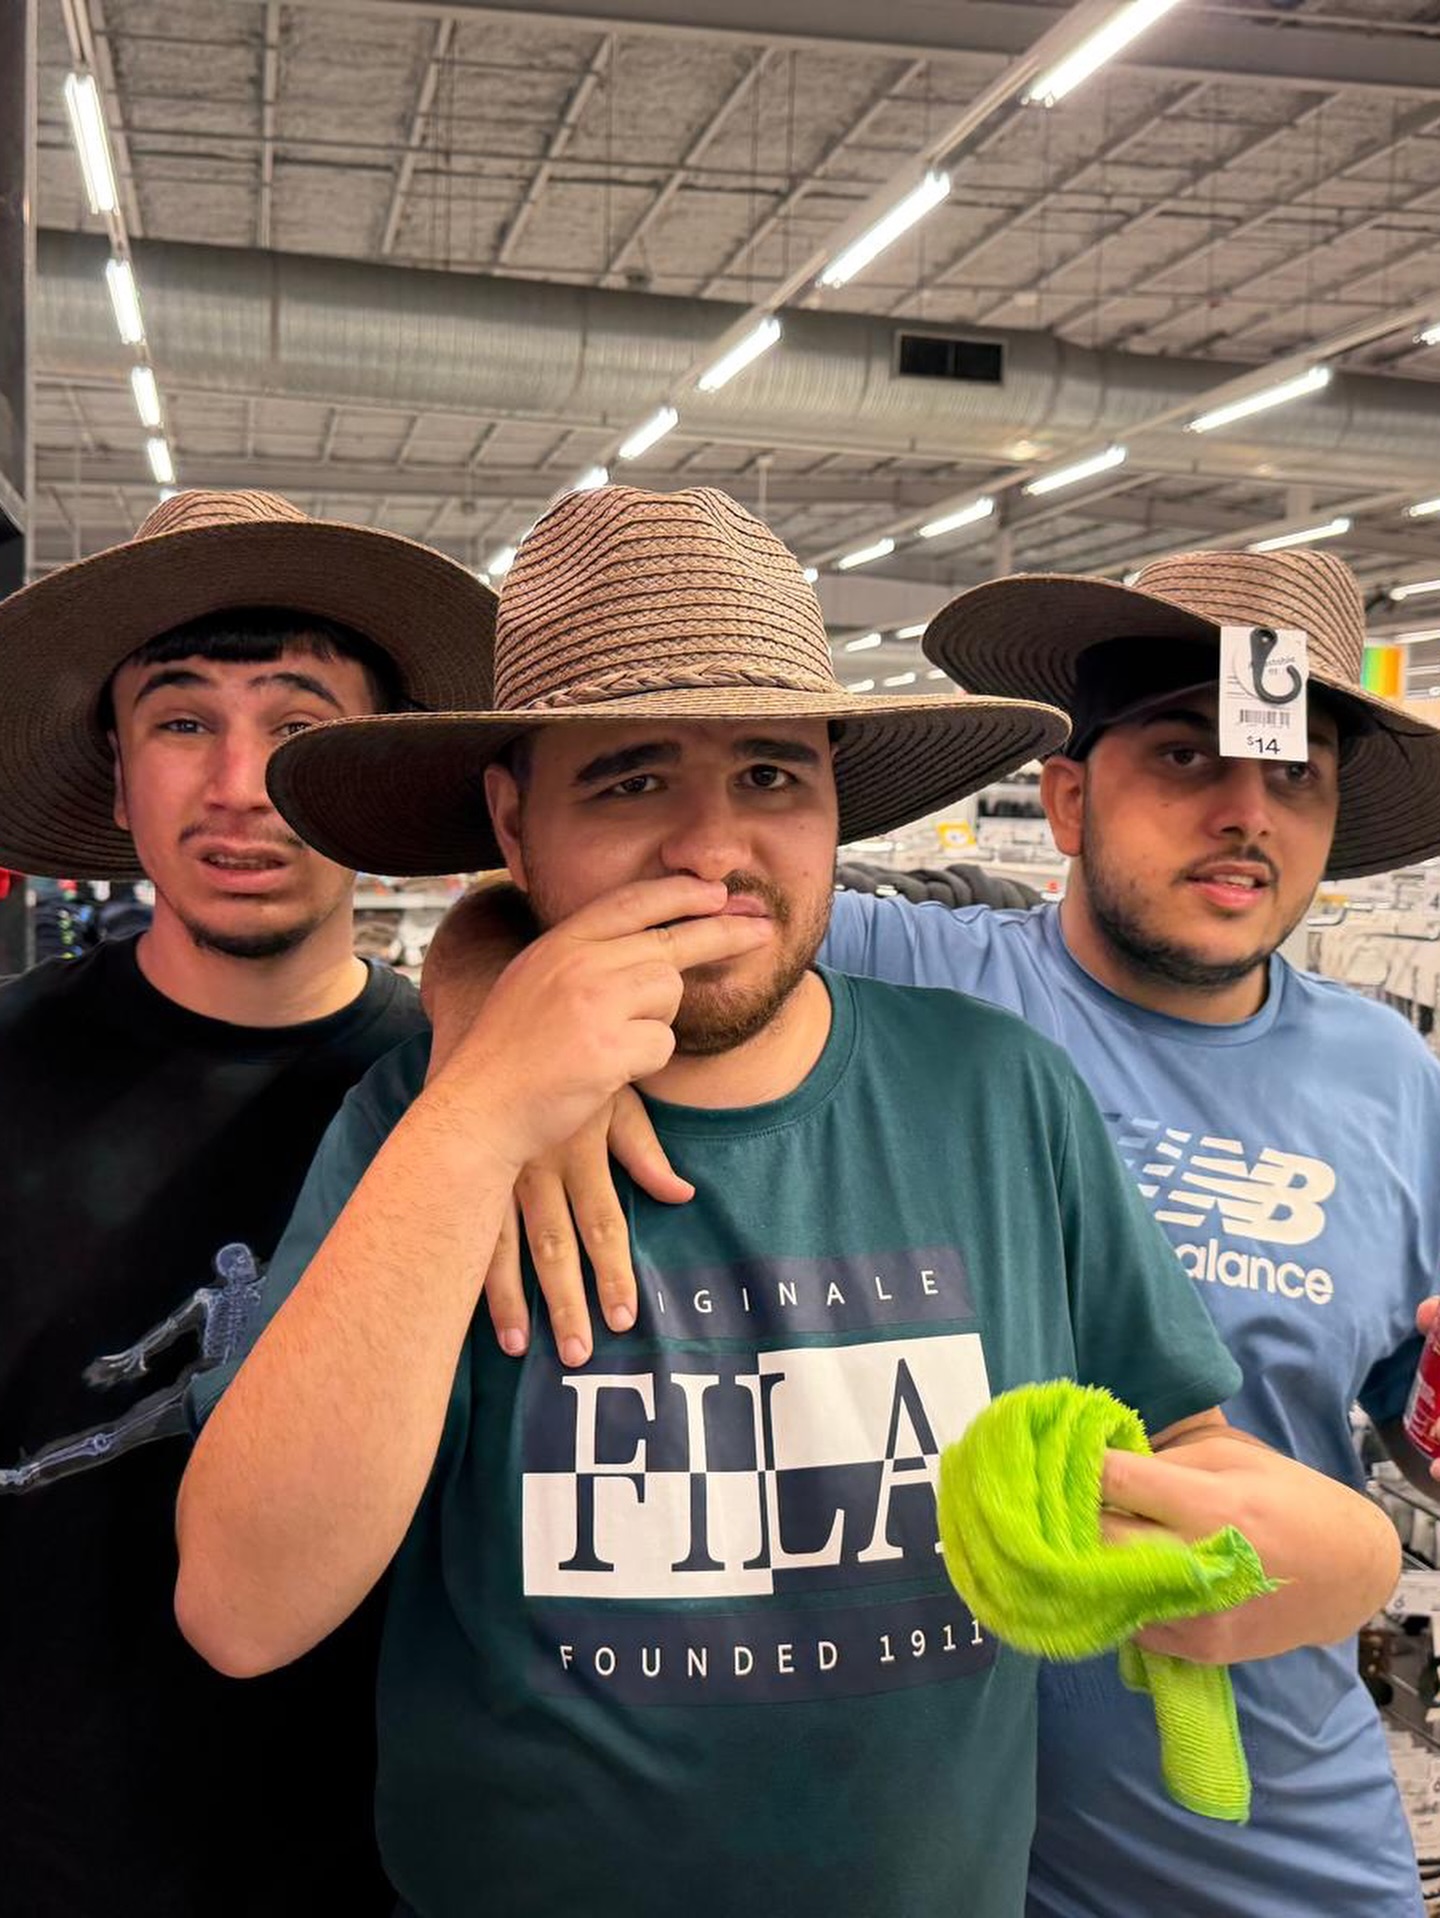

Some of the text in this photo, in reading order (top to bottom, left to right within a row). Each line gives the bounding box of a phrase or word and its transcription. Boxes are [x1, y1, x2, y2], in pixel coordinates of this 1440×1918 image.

[1246, 735, 1280, 754] $14
[657, 1269, 939, 1314] IGINALE
[1174, 1238, 1333, 1305] alance
[558, 1357, 946, 1573] FILA
[560, 1619, 984, 1678] FOUNDED 1911
